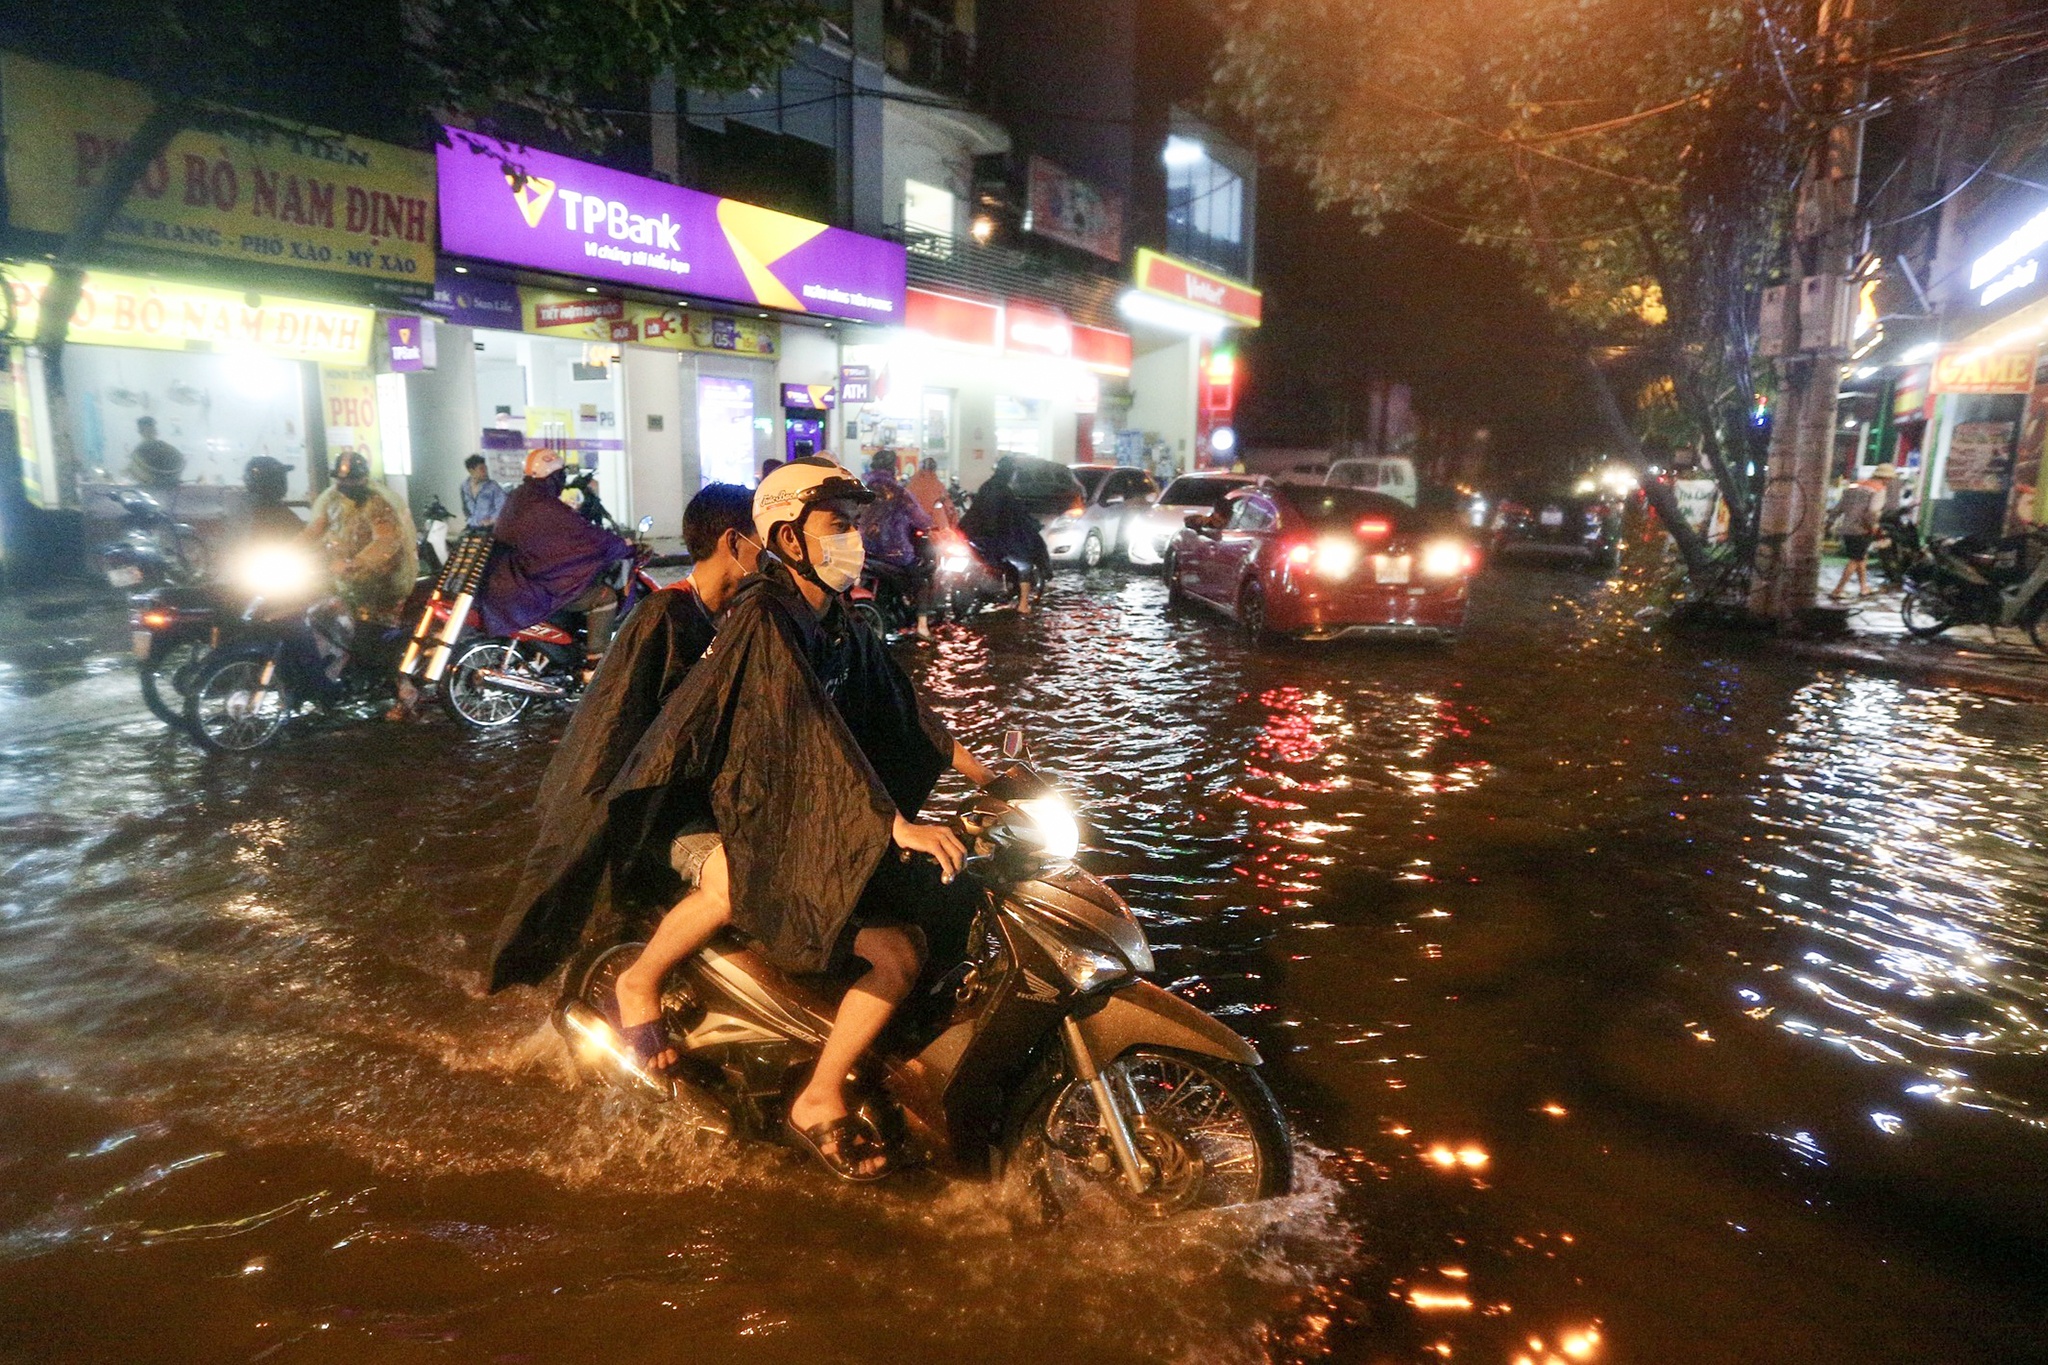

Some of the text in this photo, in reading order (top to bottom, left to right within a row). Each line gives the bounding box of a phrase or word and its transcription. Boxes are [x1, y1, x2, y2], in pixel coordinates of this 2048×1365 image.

[183, 145, 238, 212] BÒ
[252, 166, 335, 229] NAM
[346, 184, 428, 246] ĐỊNH
[558, 188, 681, 252] TPBank
[153, 220, 223, 248] RANG
[290, 238, 333, 263] XÀO
[379, 252, 418, 274] XÀO
[113, 286, 166, 334] BÒ
[182, 302, 265, 343] NAM
[274, 310, 361, 354] ĐỊNH
[662, 310, 682, 341] 3
[1937, 352, 2030, 386] GAME
[329, 386, 375, 429] PHỞ
[842, 383, 867, 400] ATM
[1016, 991, 1059, 1005] HONDA
